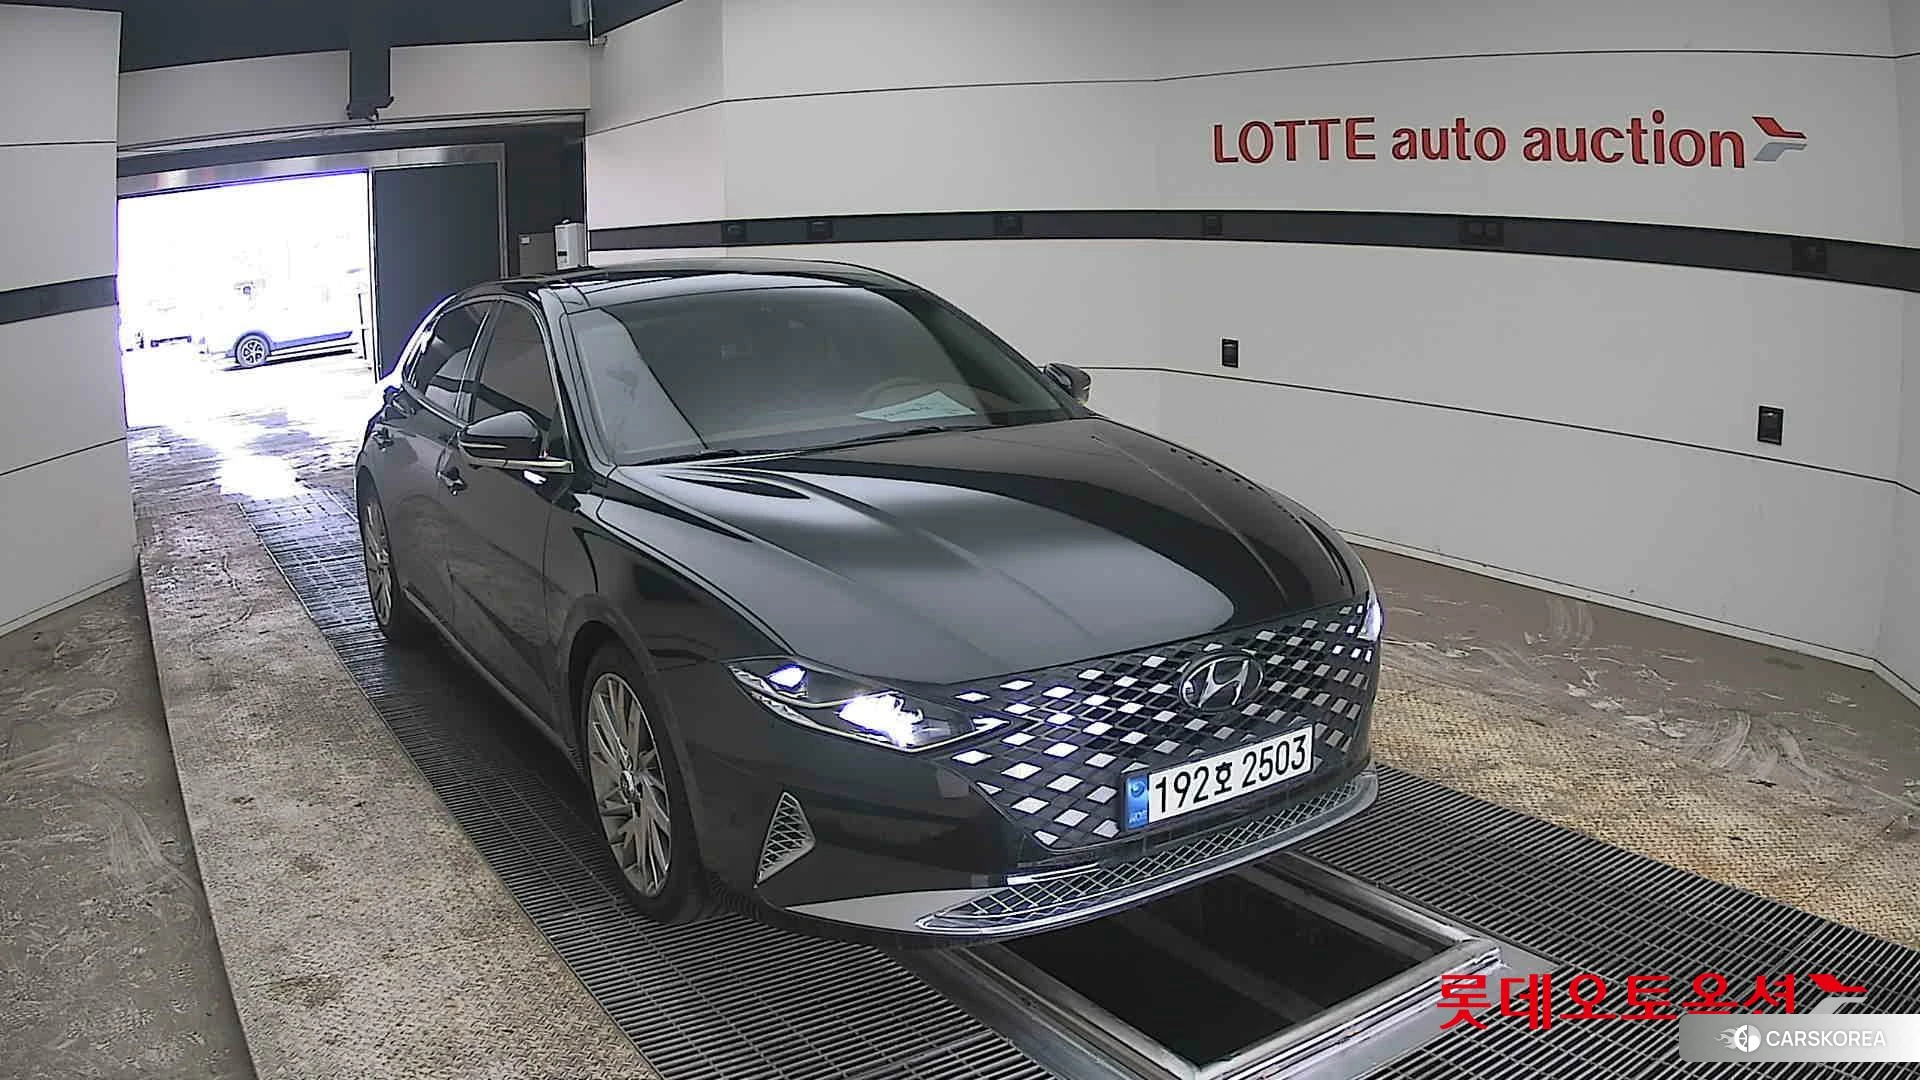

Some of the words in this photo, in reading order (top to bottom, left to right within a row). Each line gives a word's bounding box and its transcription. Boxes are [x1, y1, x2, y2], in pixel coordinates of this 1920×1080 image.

[1213, 117, 1376, 164] LOTTE
[1391, 117, 1507, 162] auto
[1522, 109, 1746, 169] auction
[1155, 761, 1233, 813] 192호
[1241, 734, 1308, 788] 2503
